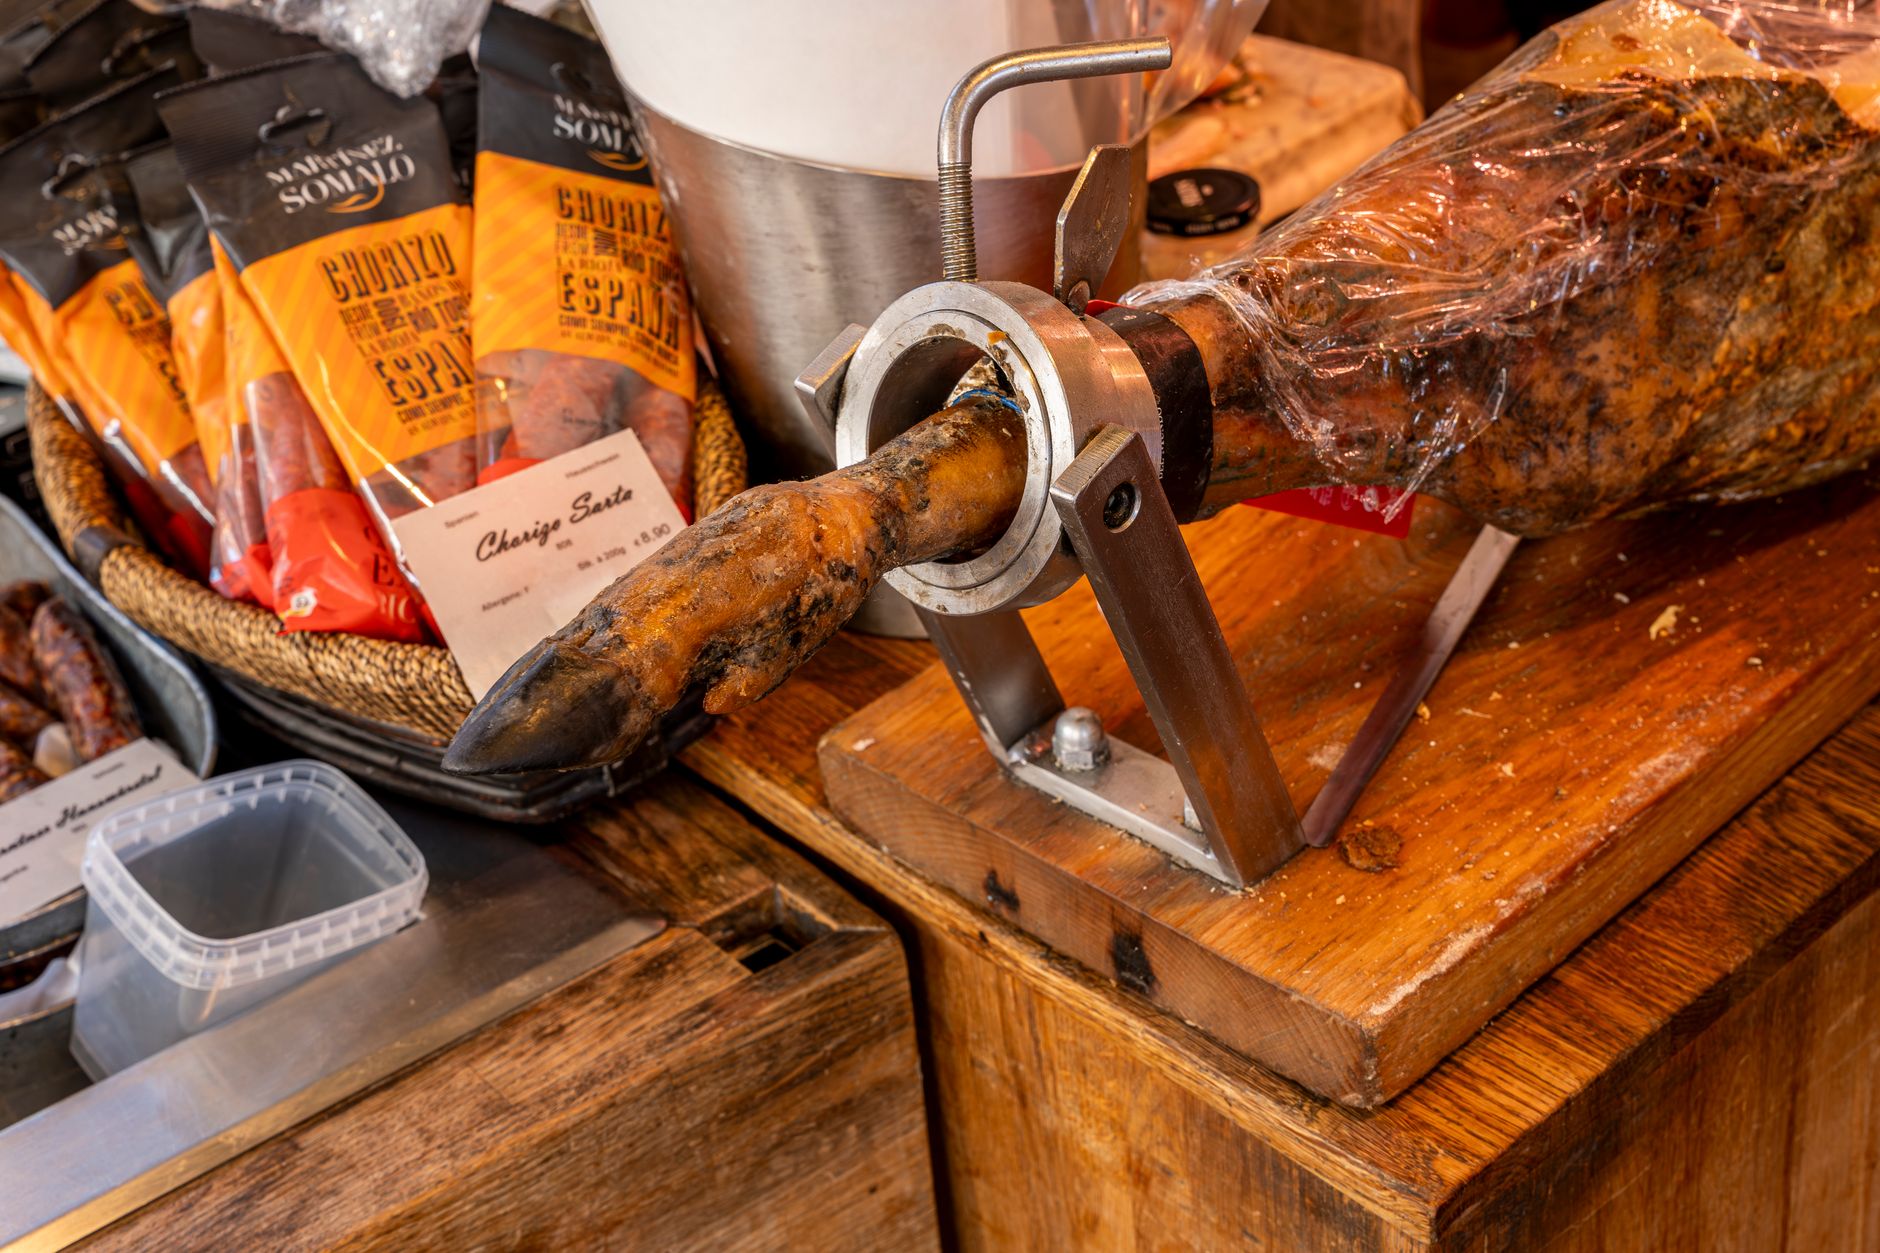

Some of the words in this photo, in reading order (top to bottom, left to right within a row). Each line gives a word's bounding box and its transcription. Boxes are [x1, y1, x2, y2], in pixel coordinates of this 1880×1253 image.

[553, 114, 644, 158] SOMA
[279, 153, 416, 214] SOMALO
[555, 183, 668, 243] CHORIZ
[316, 230, 456, 302] CHORIZO
[475, 516, 562, 562] Chorizo
[569, 484, 634, 524] Sarta
